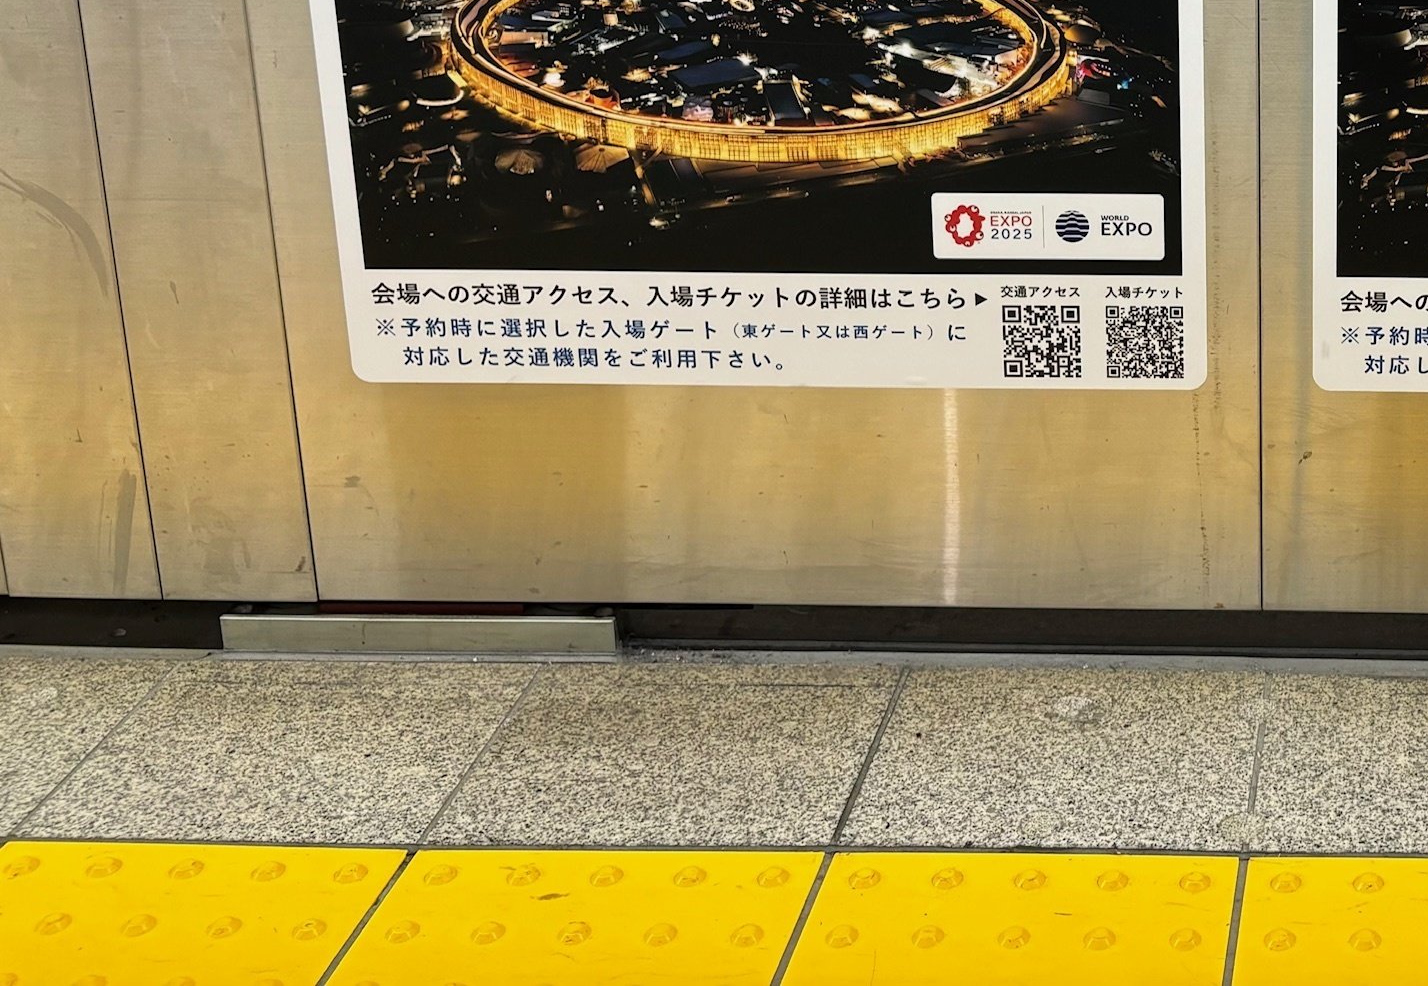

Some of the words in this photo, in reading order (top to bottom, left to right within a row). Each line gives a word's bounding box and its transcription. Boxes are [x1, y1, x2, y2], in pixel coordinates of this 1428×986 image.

[990, 215, 1032, 227] EXPO
[991, 228, 1032, 240] 2025
[1101, 222, 1153, 236] EXPO
[1000, 285, 1081, 299] 交通アクセス
[1104, 286, 1184, 300] 入場チケット
[403, 345, 783, 371] 対応した交通機関をご利用下さい。
